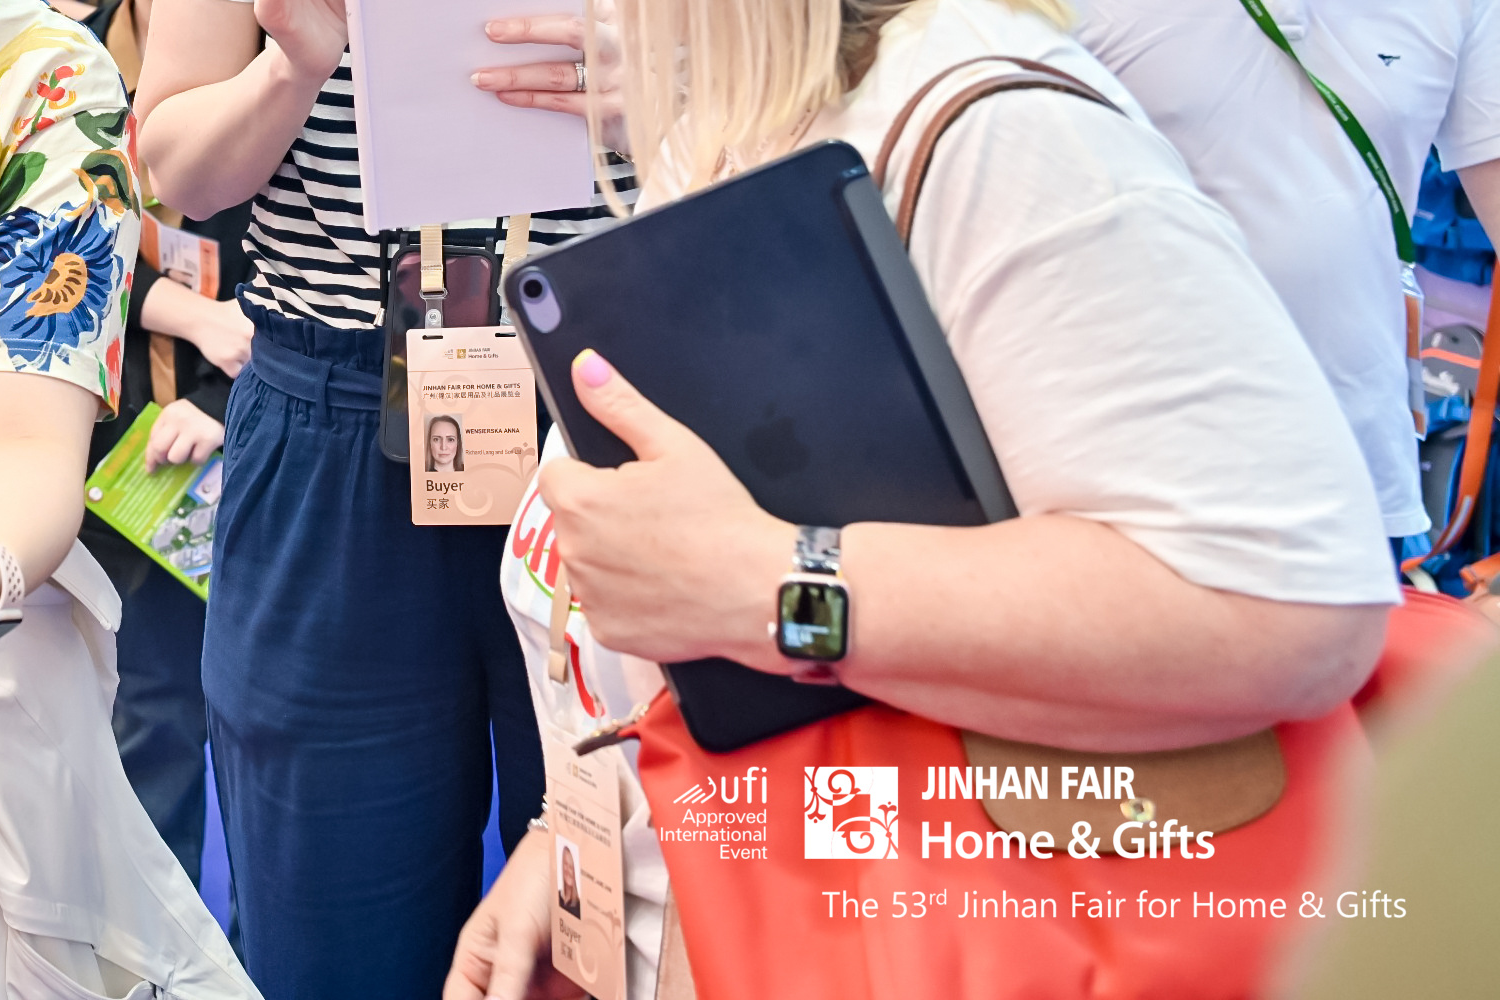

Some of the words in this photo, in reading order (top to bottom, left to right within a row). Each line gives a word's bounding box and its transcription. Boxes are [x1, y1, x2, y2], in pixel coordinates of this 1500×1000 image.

[426, 479, 465, 496] Buyer
[426, 497, 449, 510] 买家
[559, 917, 581, 943] Buyer
